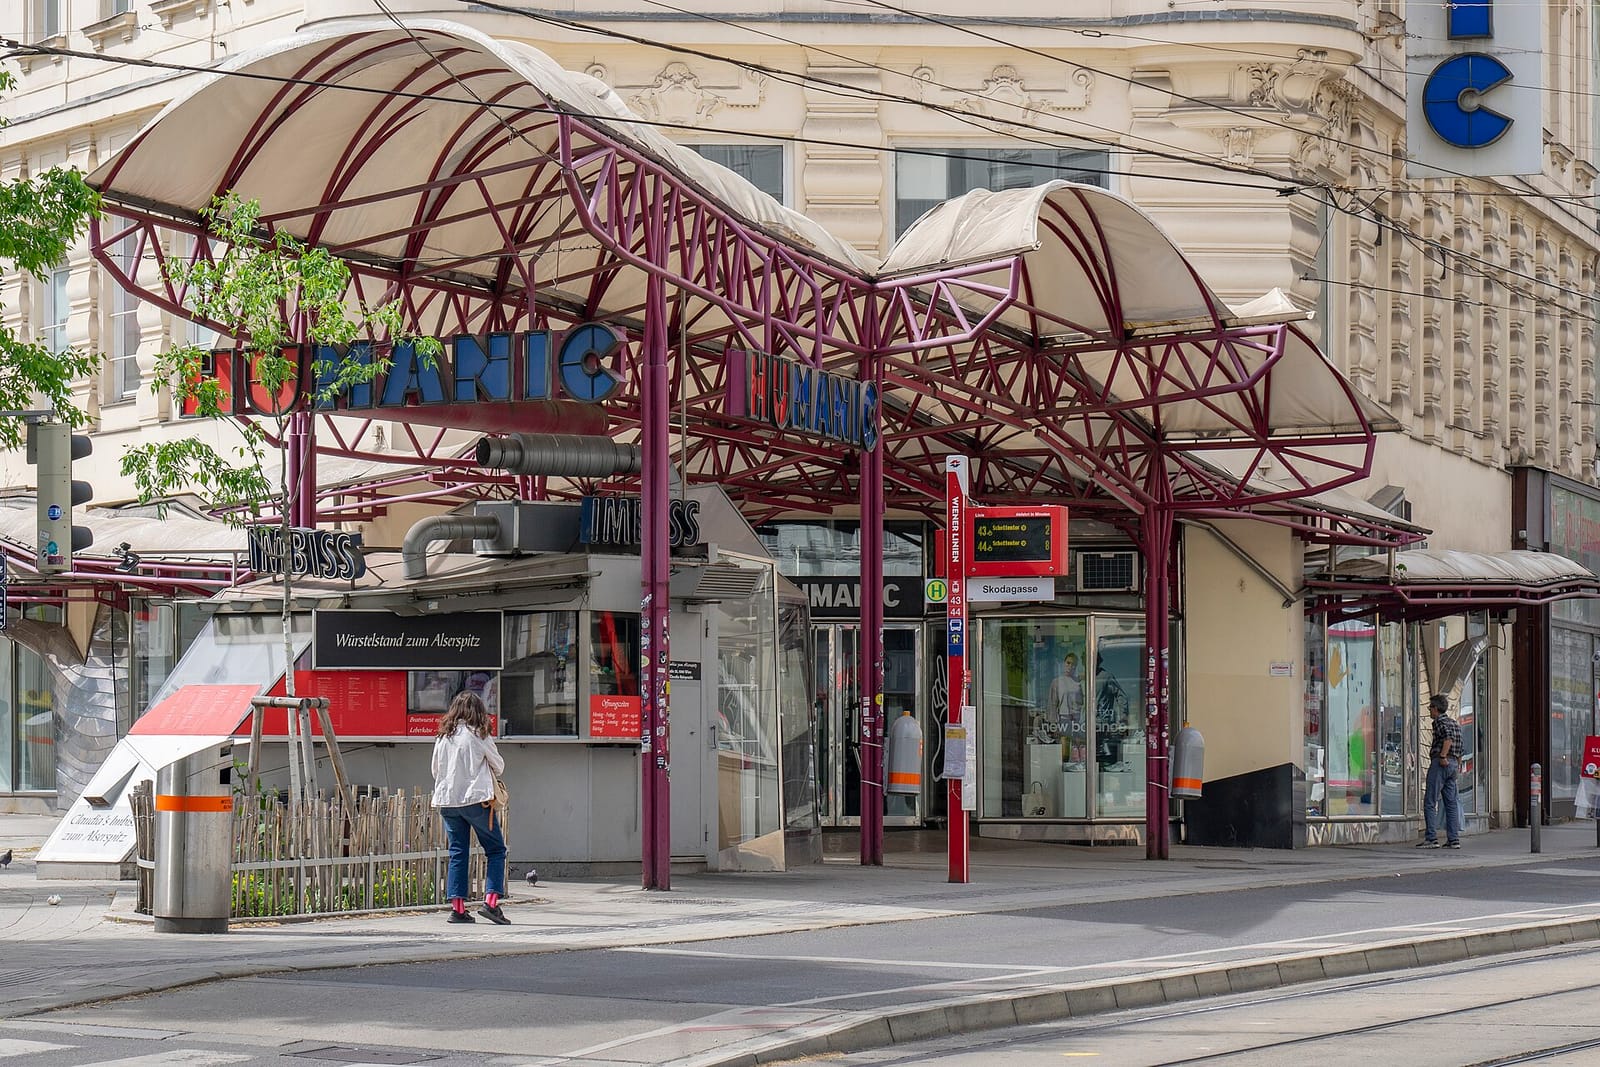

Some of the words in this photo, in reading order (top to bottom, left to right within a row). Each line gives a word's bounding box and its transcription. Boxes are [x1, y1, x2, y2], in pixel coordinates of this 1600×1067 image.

[746, 349, 879, 453] HUMANIC
[978, 526, 987, 537] 43
[1045, 525, 1050, 536] 2
[978, 541, 987, 552] 44
[1045, 540, 1050, 551] 8
[982, 585, 1038, 595] Skodagasse
[950, 596, 961, 605] 43
[950, 608, 961, 616] 44
[336, 633, 404, 648] Würstelstand
[405, 637, 429, 648] zum
[431, 633, 481, 652] Alserspitz
[1041, 721, 1068, 733] new
